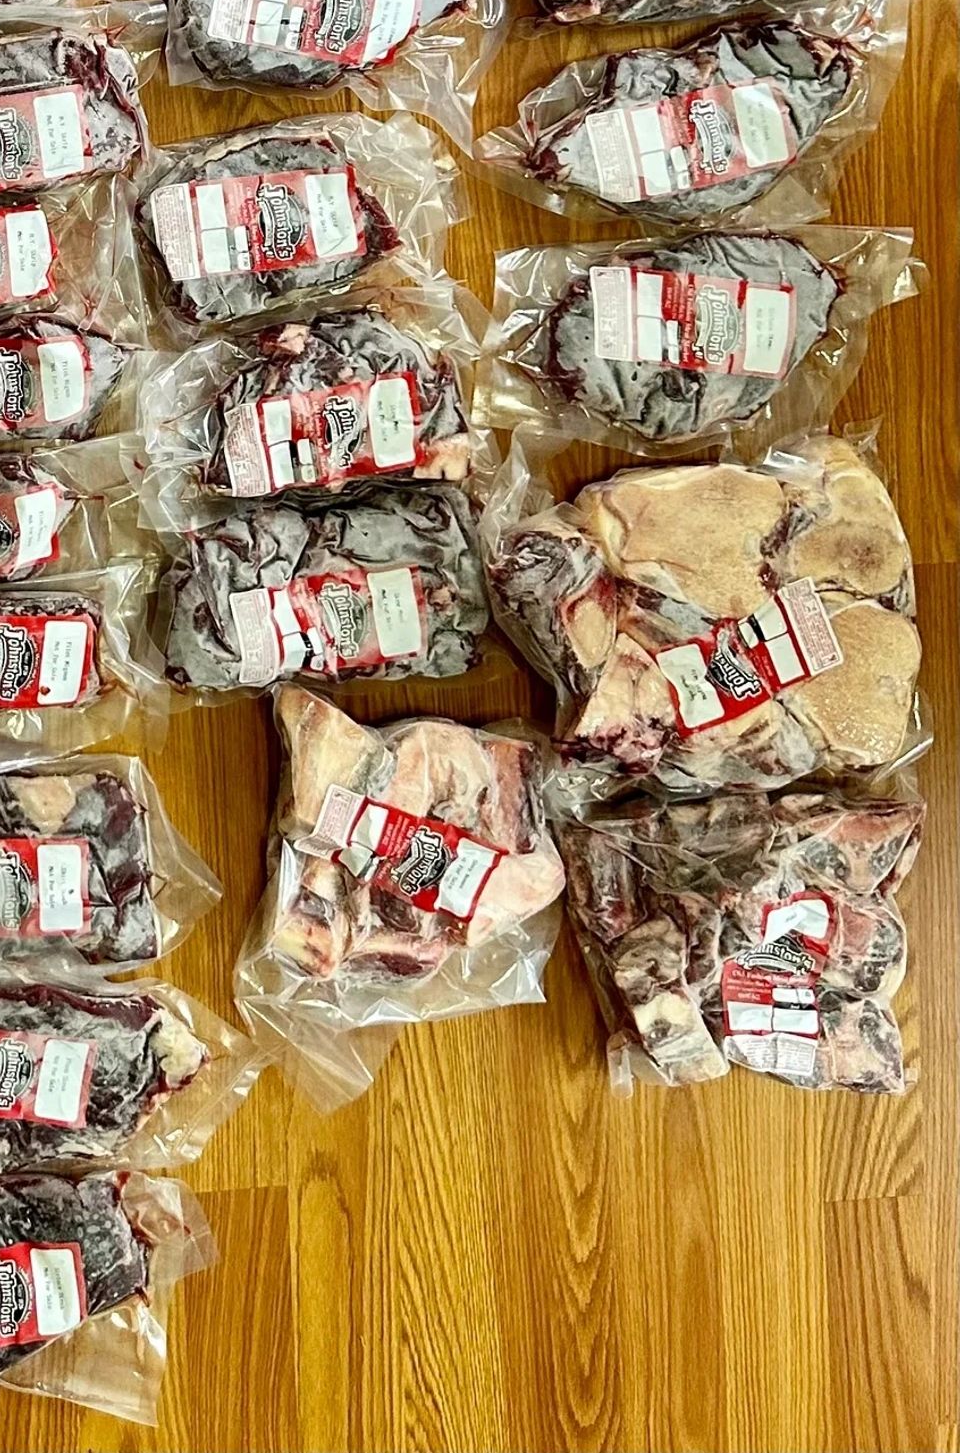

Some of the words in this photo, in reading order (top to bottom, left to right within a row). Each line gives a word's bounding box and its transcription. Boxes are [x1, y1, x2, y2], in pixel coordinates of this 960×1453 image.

[697, 102, 725, 173] Johnston's
[270, 187, 294, 259] Johnston's
[703, 291, 727, 363] Johnston's
[0, 353, 18, 419] Johnston's
[332, 586, 355, 657] Johnston's
[0, 630, 22, 698] Johnston's
[399, 830, 443, 899] Johnston's
